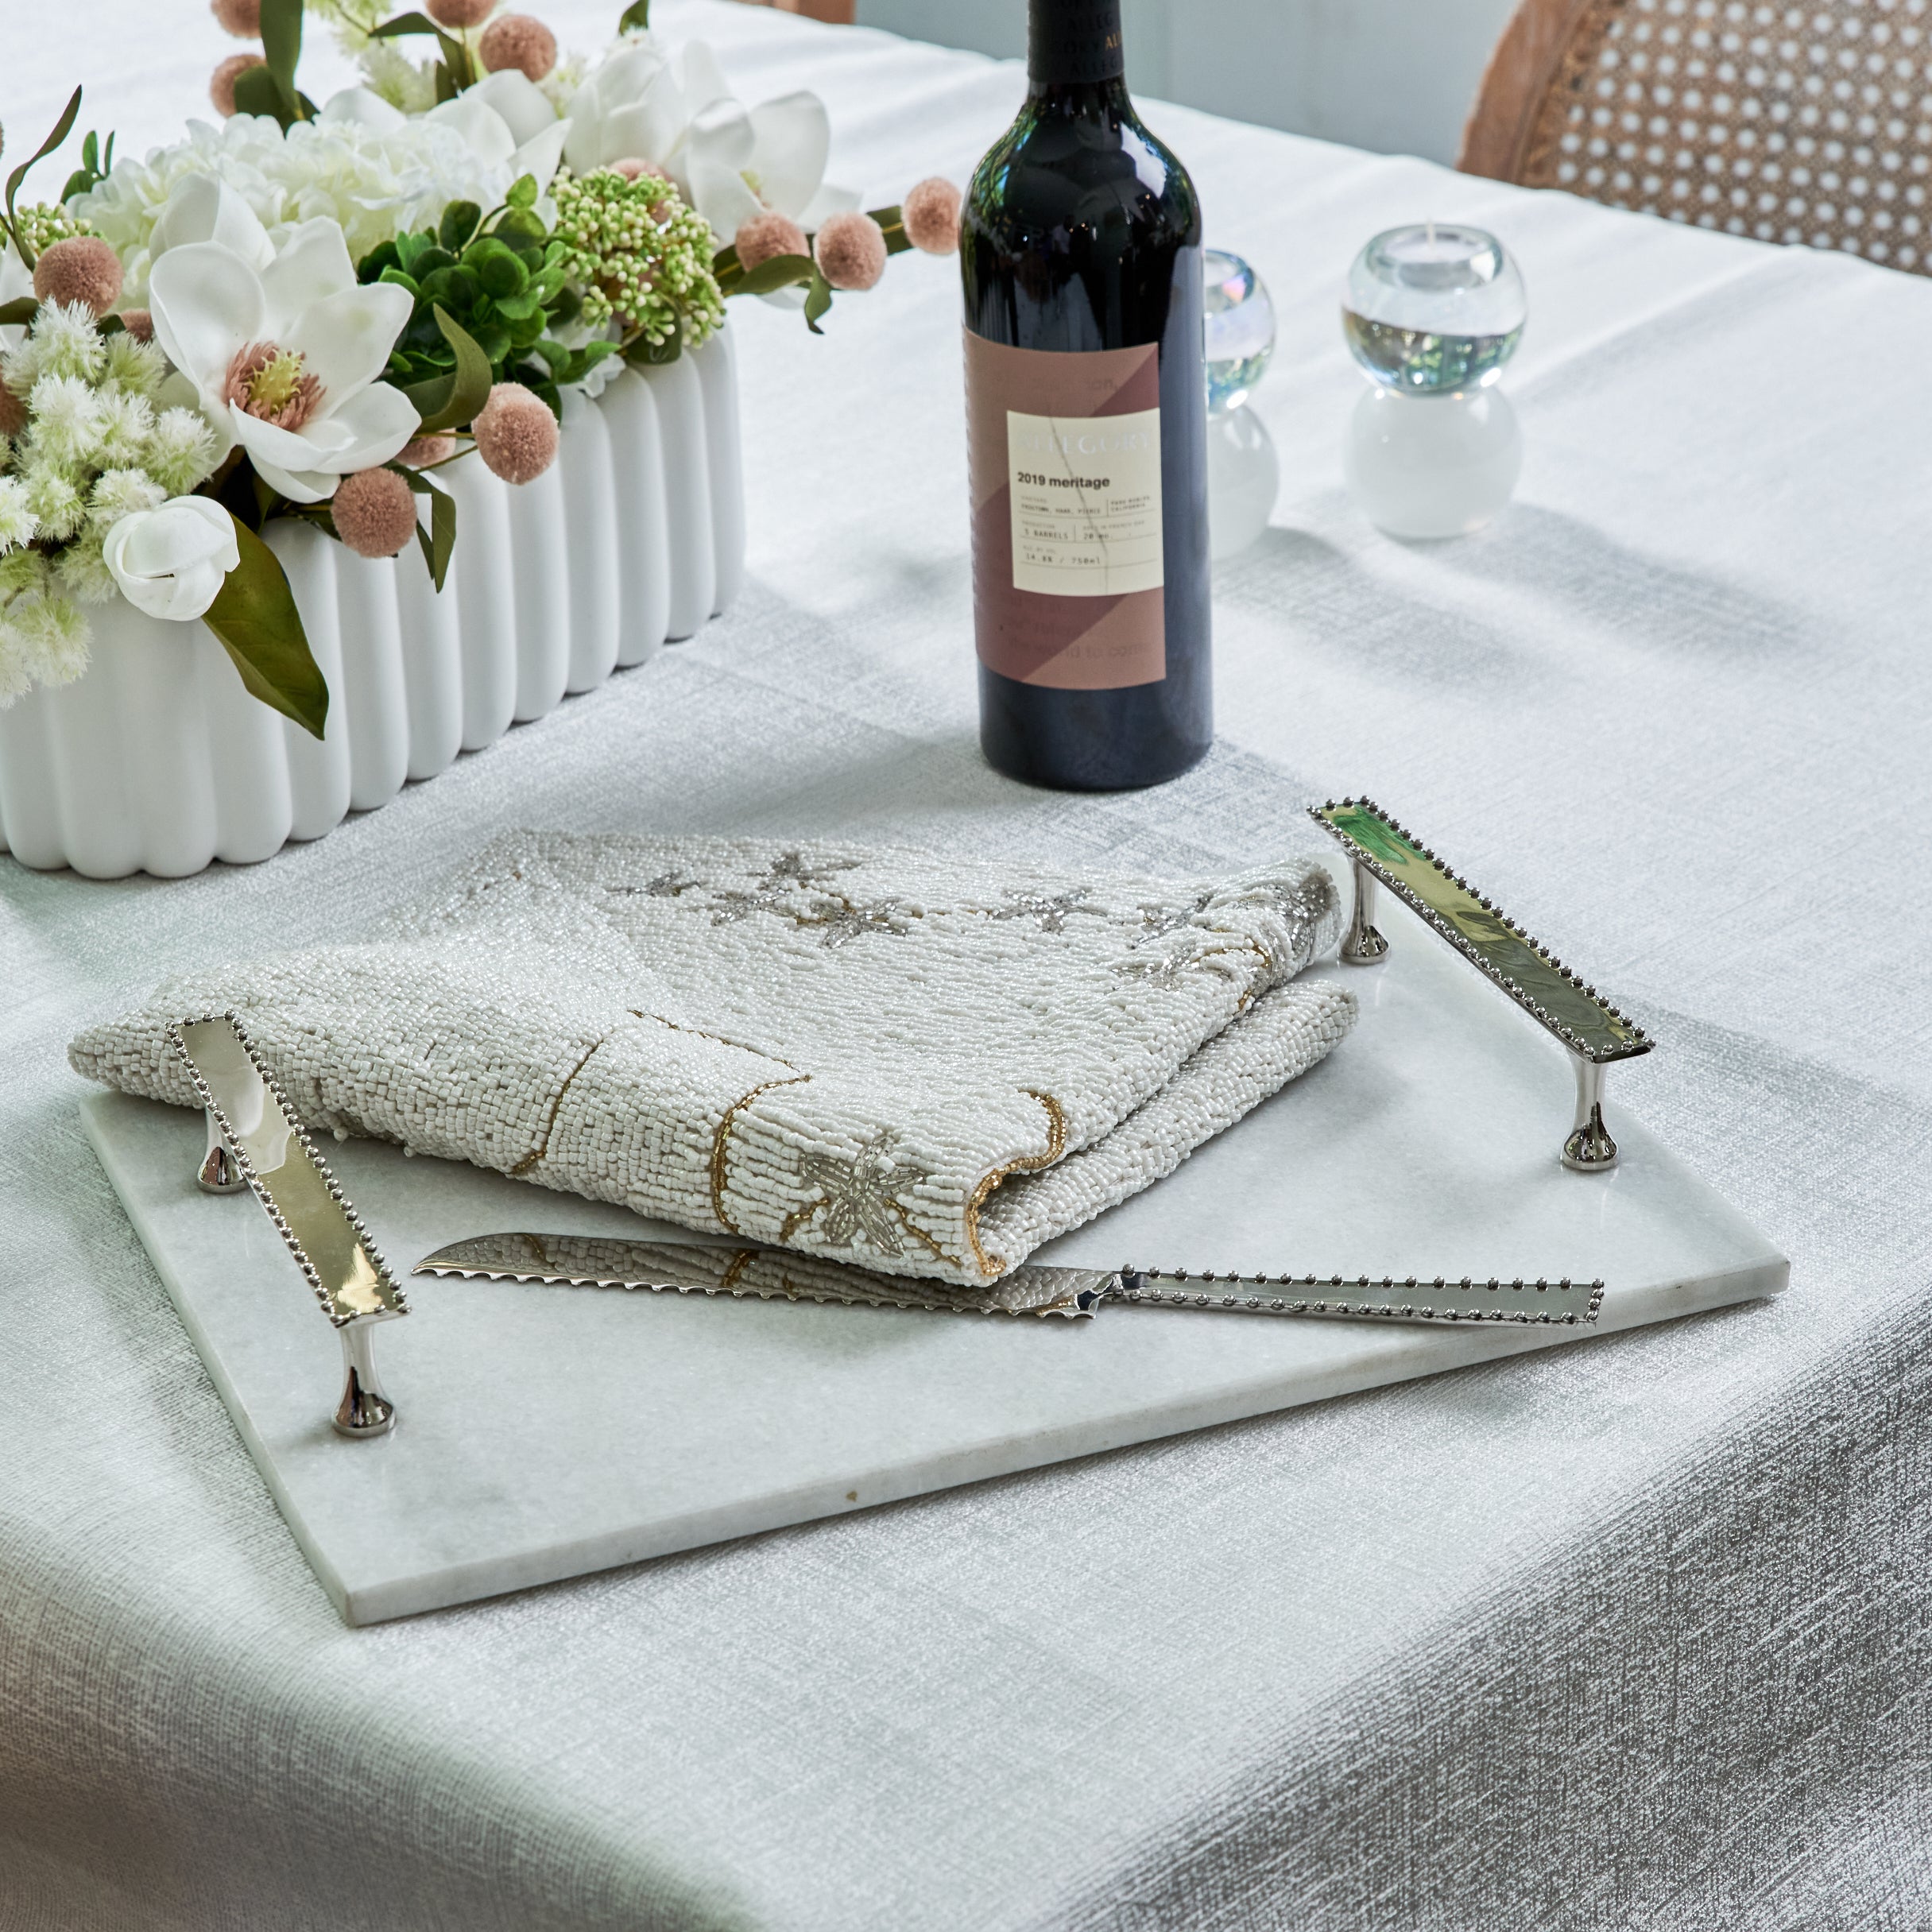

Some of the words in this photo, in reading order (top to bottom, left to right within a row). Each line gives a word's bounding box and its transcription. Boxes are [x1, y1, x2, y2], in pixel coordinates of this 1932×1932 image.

[1018, 472, 1046, 486] 2019
[1049, 477, 1110, 490] meritage
[1034, 529, 1069, 540] BARRELS
[1071, 556, 1100, 565] 750ml
